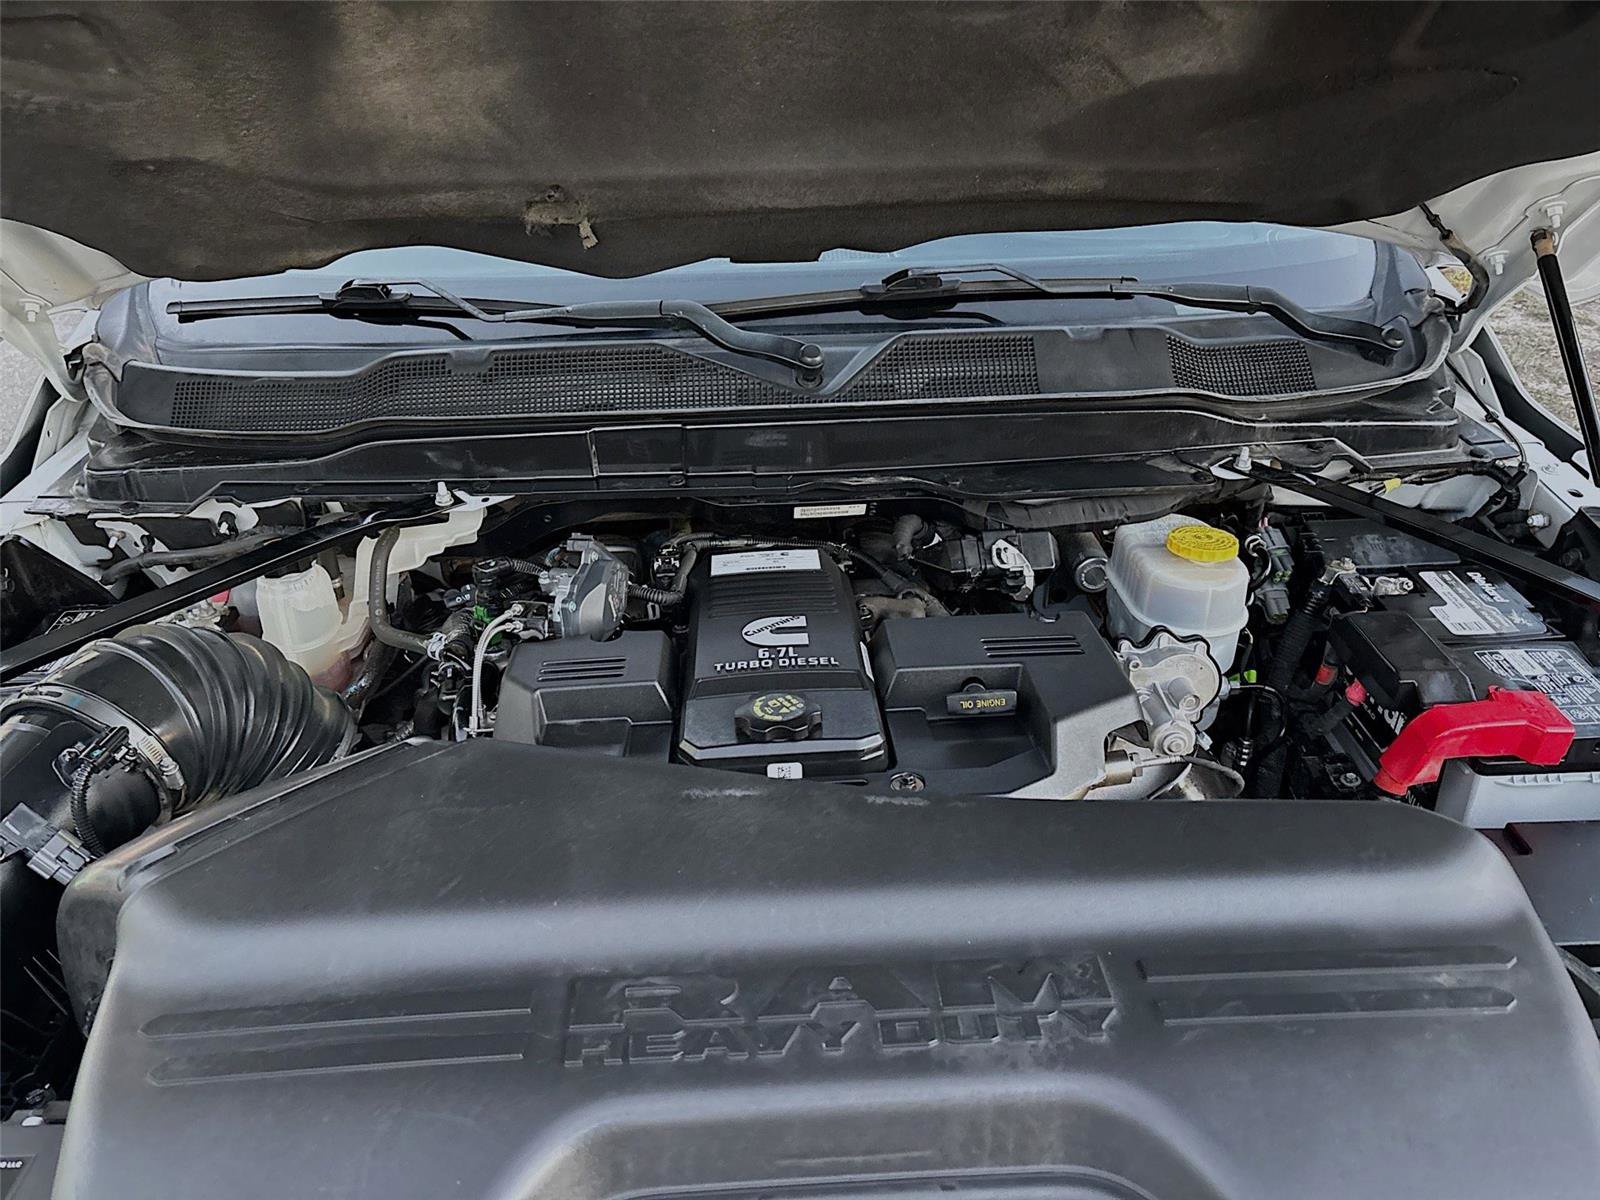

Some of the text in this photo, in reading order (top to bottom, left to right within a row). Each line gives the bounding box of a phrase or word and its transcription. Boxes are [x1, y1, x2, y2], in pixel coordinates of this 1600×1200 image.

[757, 646, 798, 659] 6.7L
[714, 656, 840, 672] TURBO DIESEL
[959, 698, 1006, 709] ENGINE OIL
[566, 954, 1117, 1032] RAM
